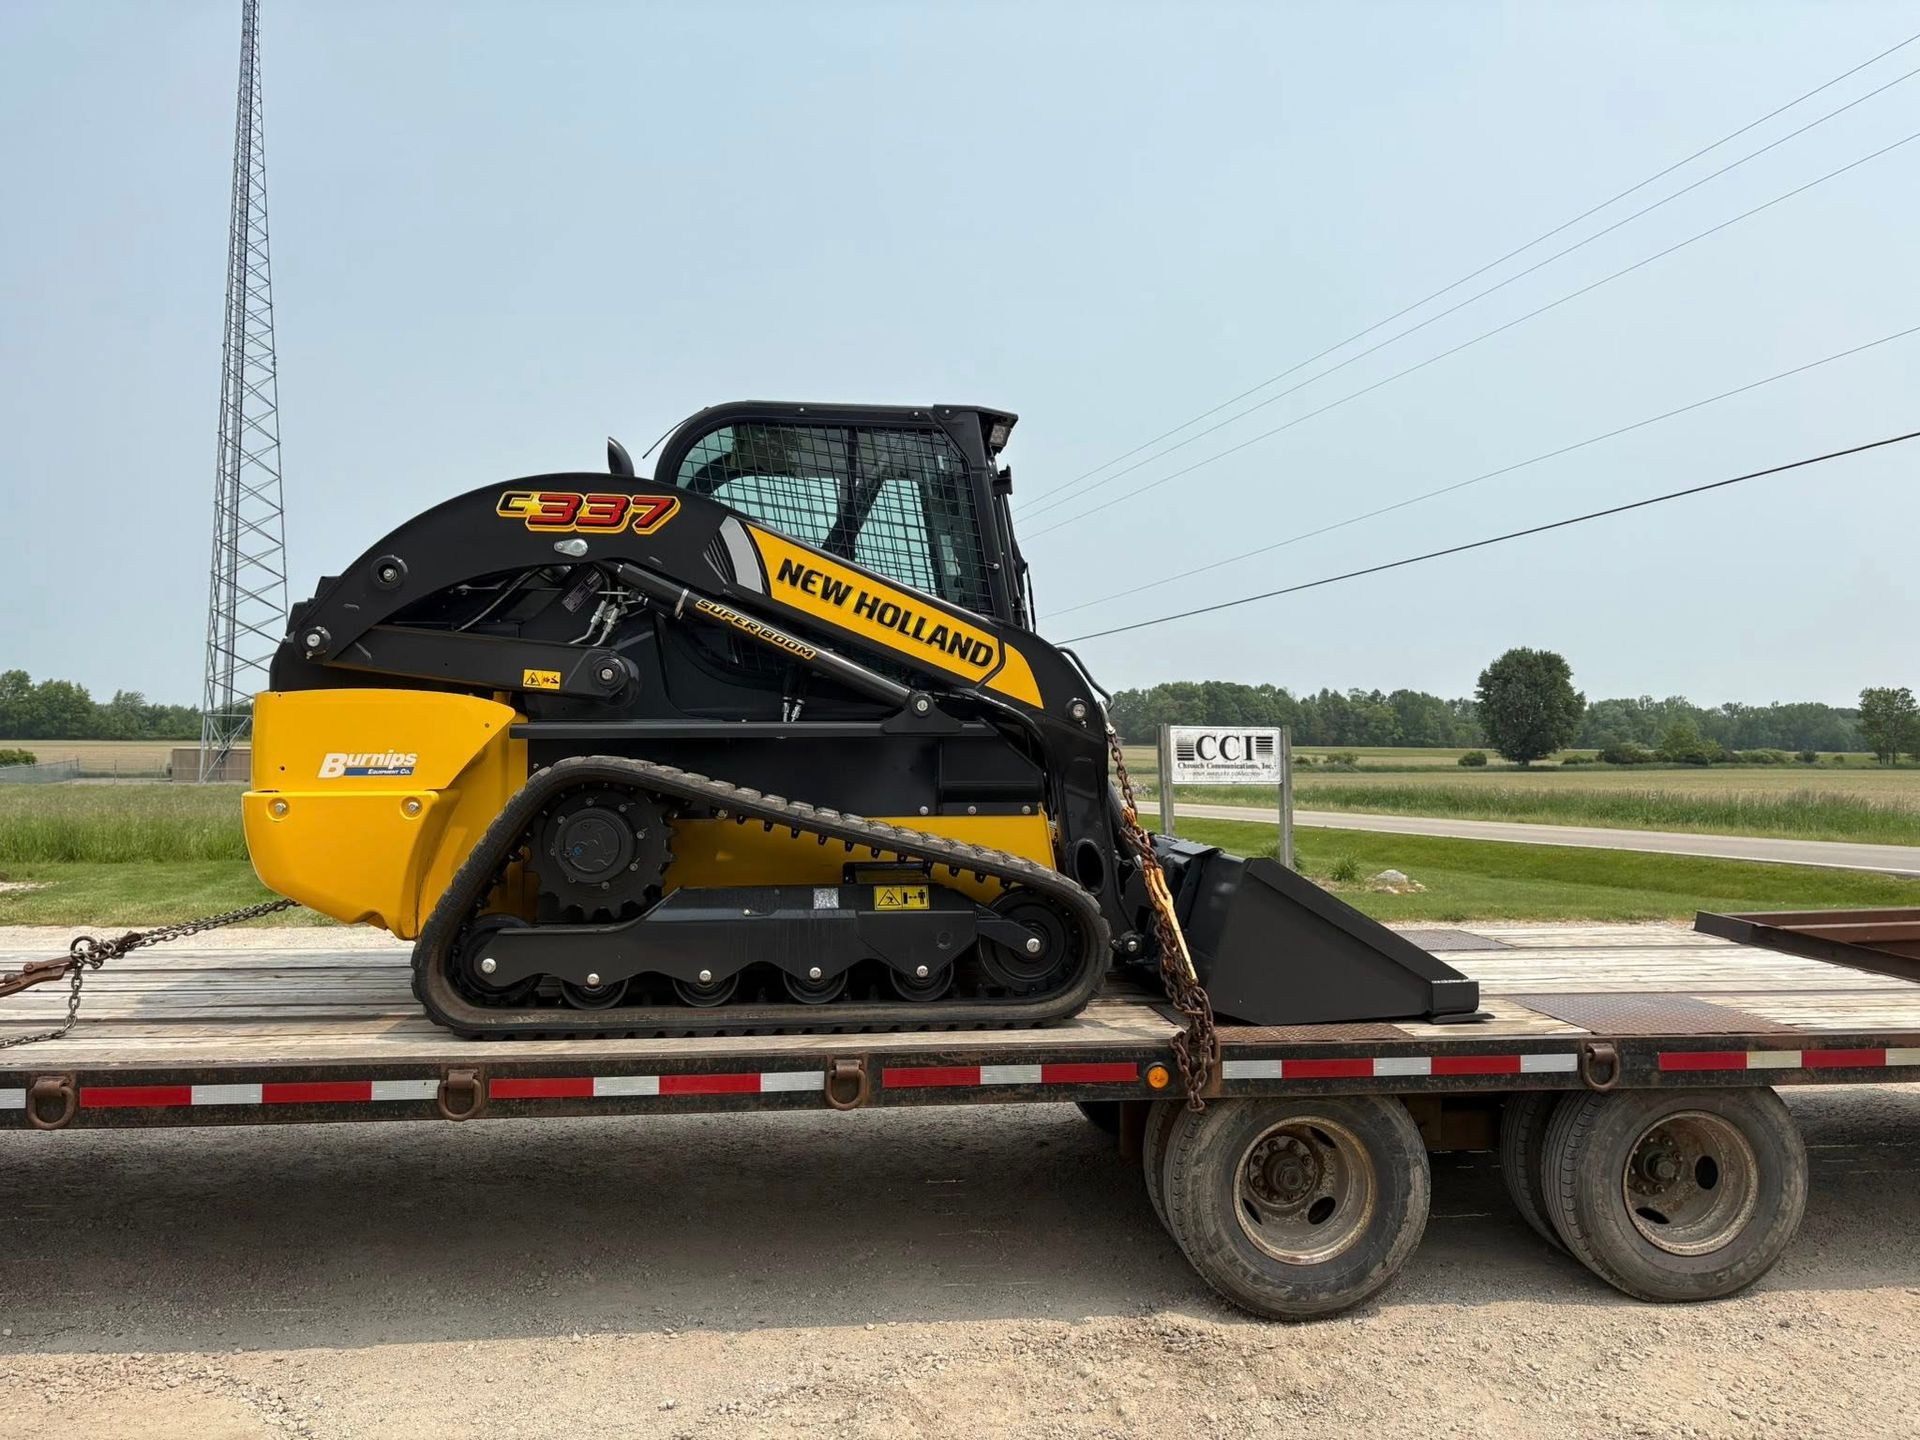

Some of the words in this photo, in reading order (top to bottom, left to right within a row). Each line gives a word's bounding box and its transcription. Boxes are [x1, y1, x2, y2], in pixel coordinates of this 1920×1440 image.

[497, 491, 681, 535] C337
[776, 558, 853, 607] NEW
[853, 591, 995, 668] HOLLAND
[1195, 735, 1255, 761] CCI
[317, 749, 418, 778] Burnips
[1206, 762, 1260, 770] Communications,
